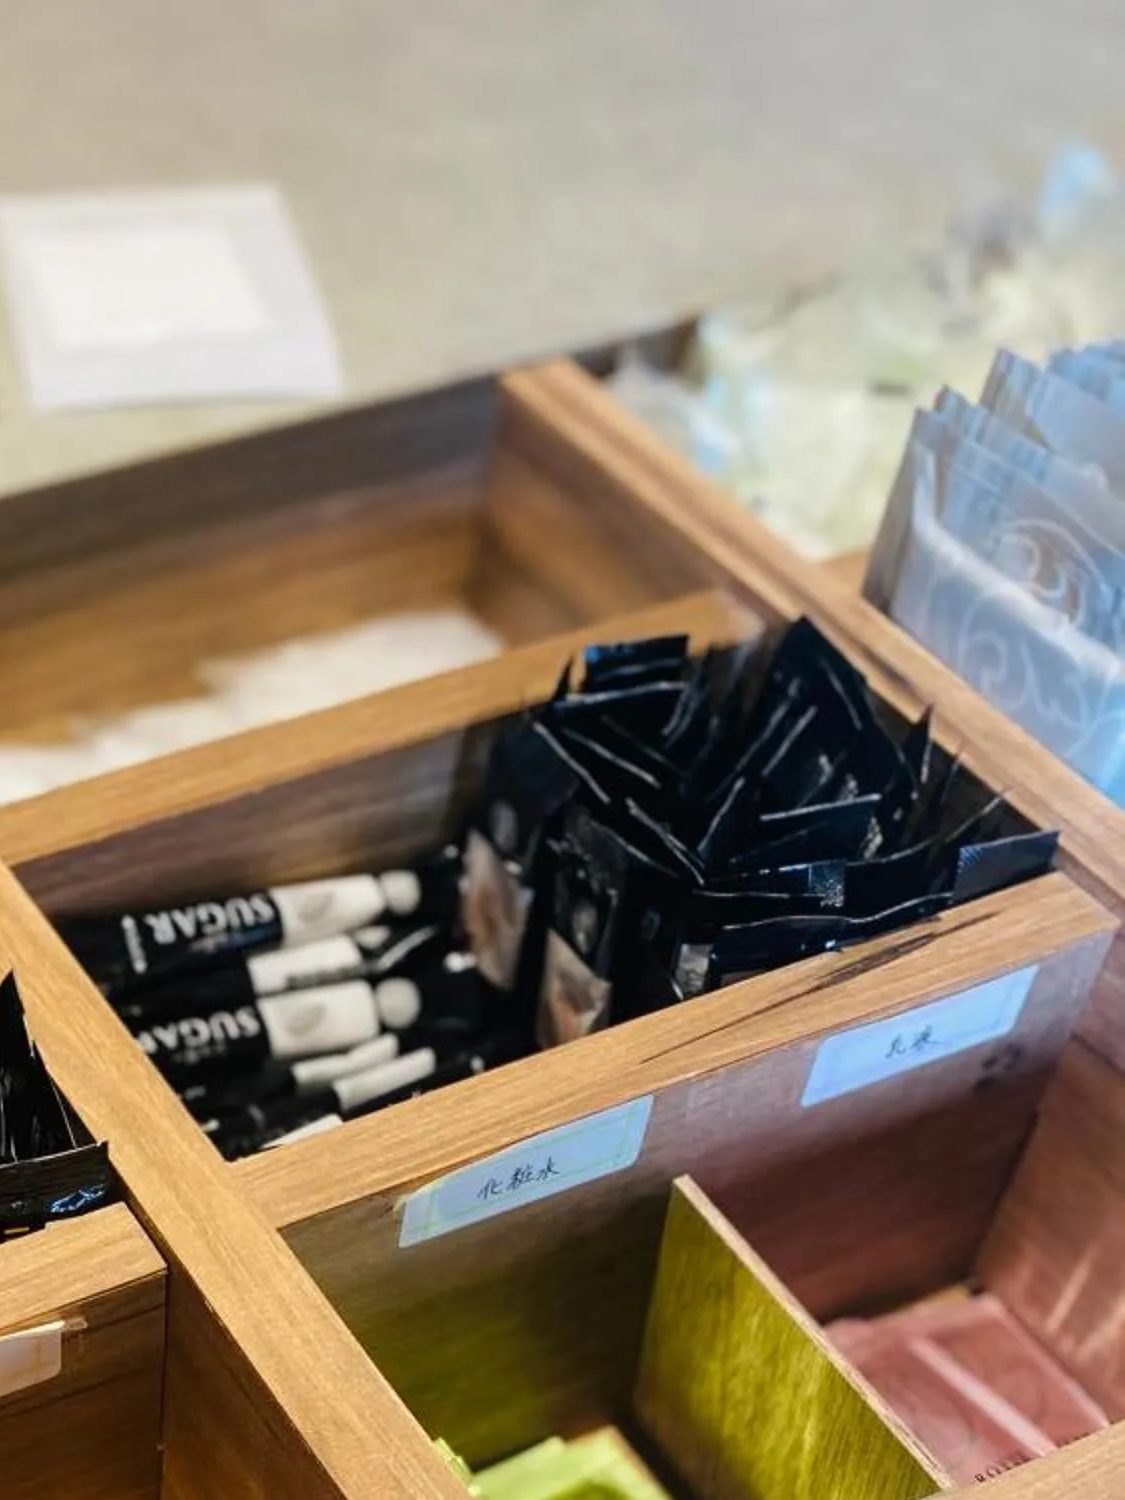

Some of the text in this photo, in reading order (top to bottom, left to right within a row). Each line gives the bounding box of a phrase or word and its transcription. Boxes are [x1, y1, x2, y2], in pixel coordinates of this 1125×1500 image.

[143, 893, 274, 945] SUGAR
[476, 1156, 560, 1200] 化粧水
